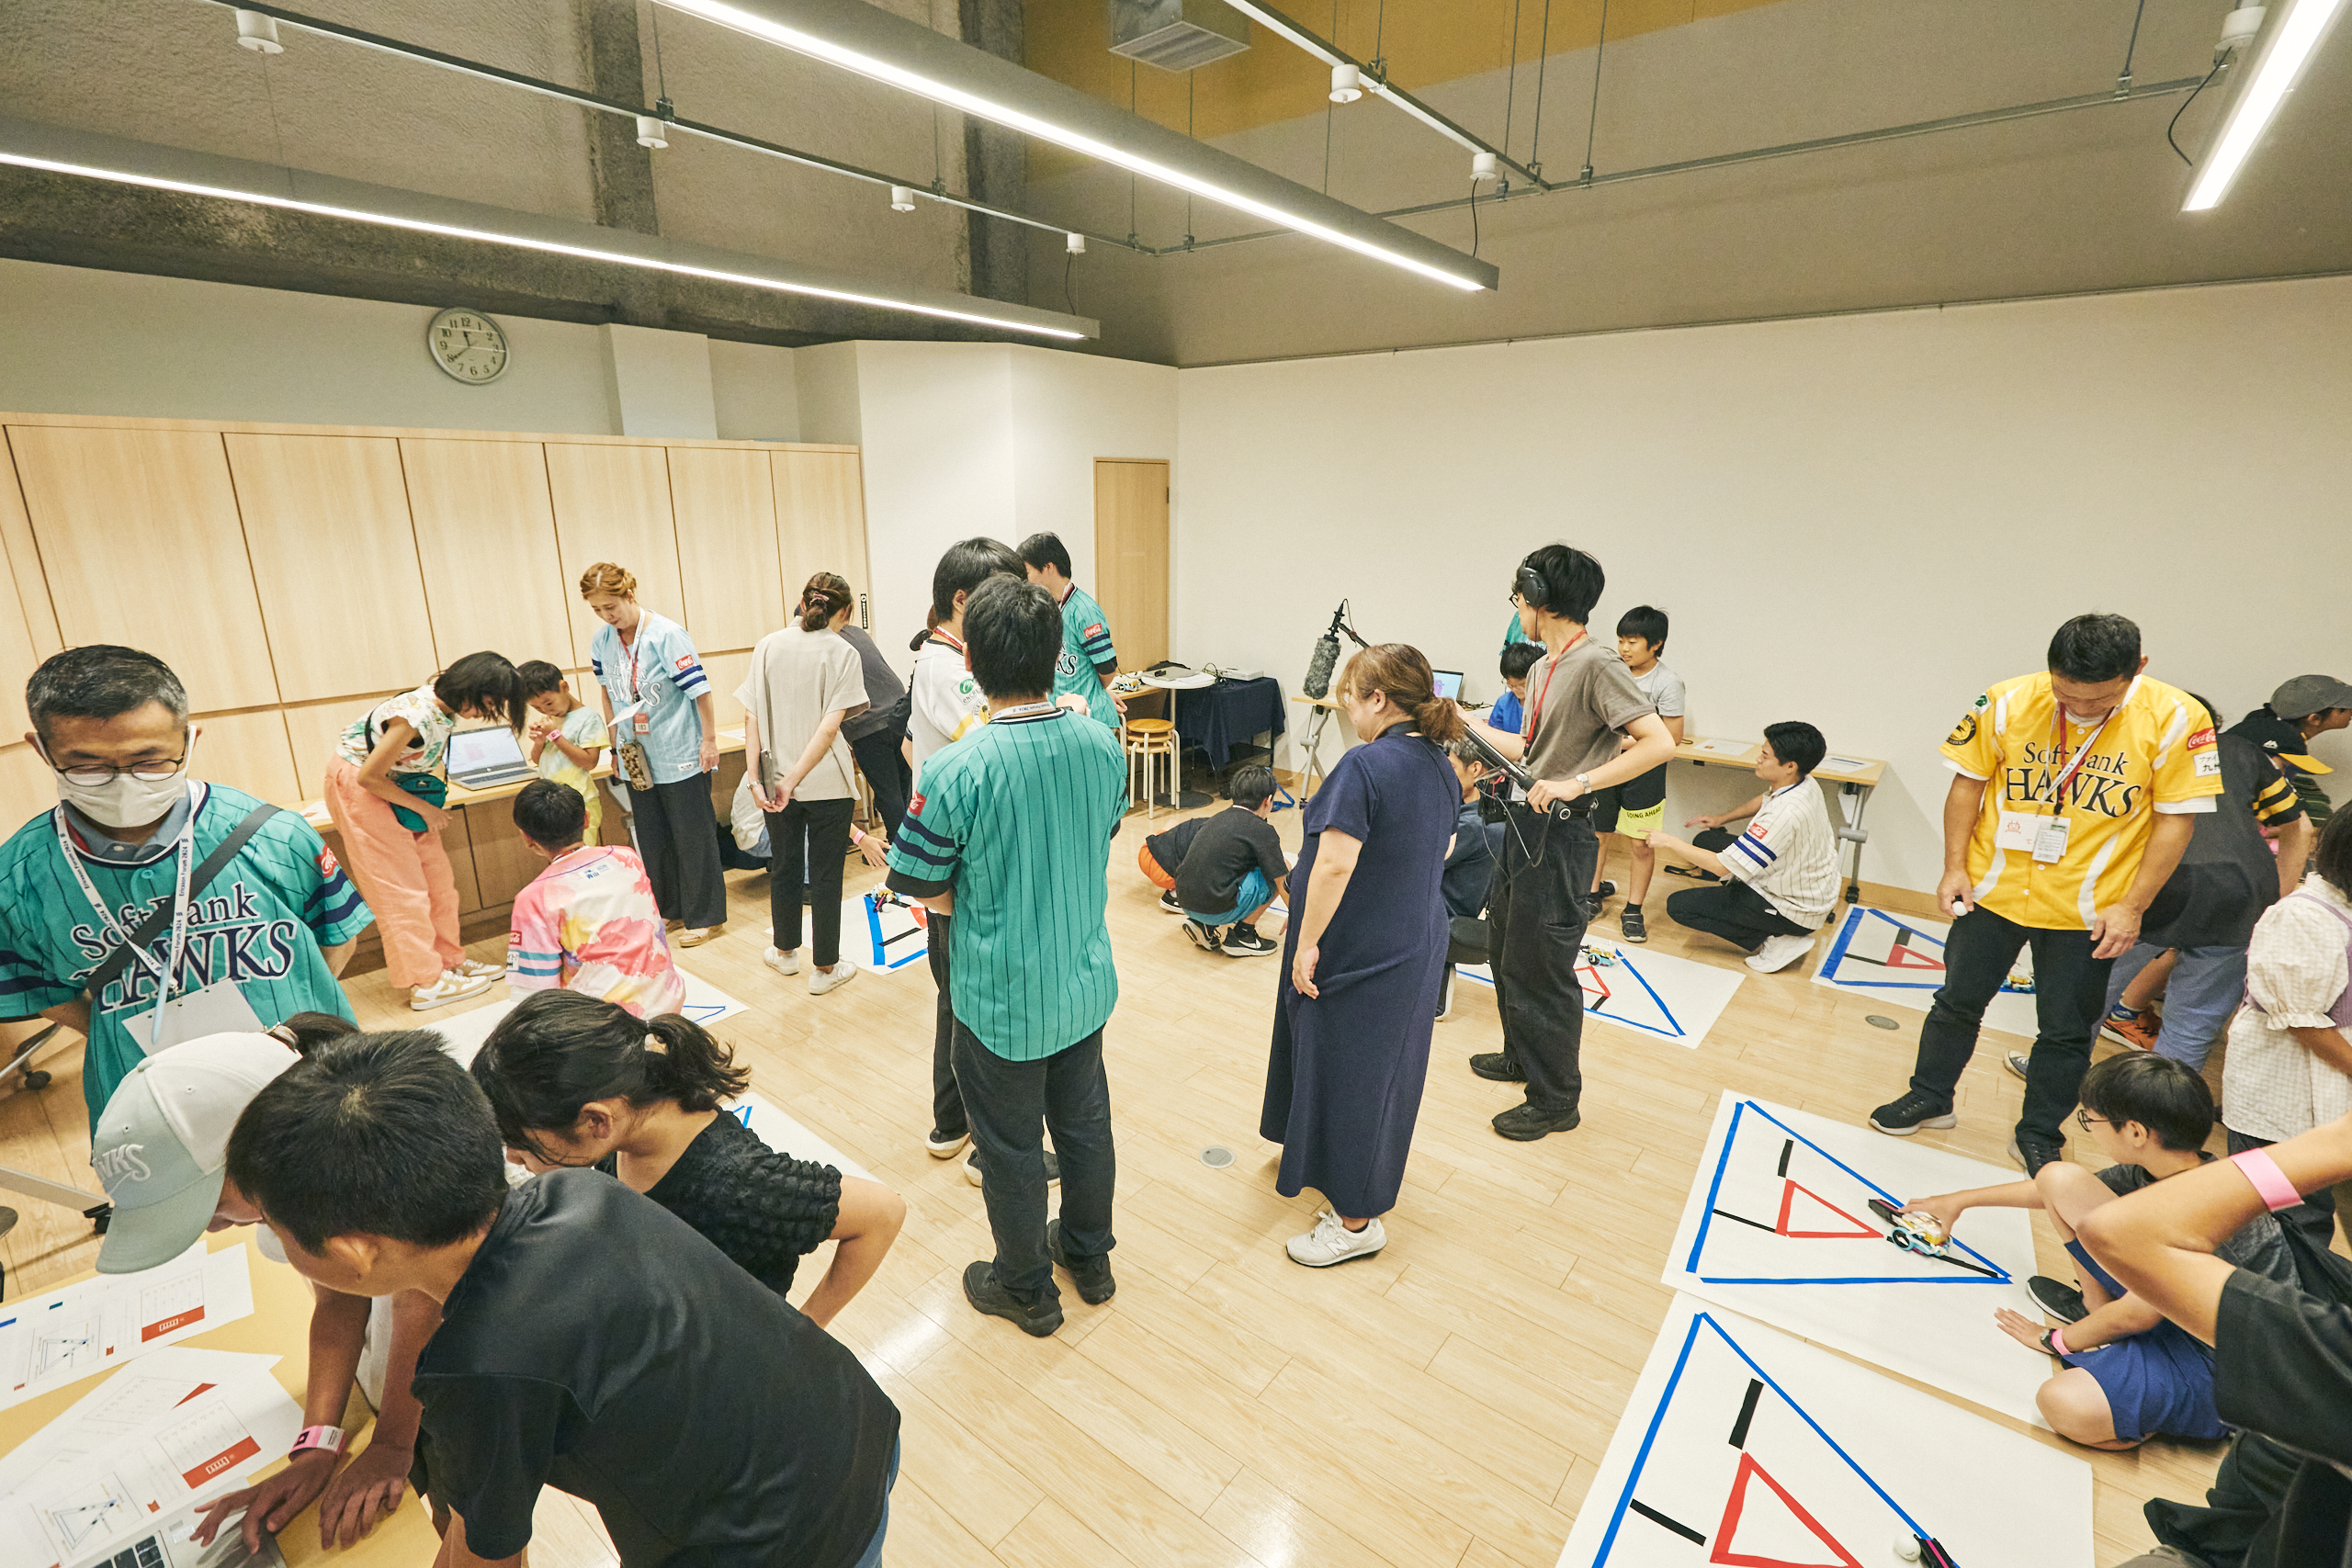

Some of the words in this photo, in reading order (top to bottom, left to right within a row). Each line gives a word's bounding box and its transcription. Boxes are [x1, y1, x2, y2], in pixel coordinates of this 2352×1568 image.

[449, 319, 458, 328] 11
[461, 317, 470, 327] 12
[477, 321, 482, 331] 1
[441, 328, 452, 338] 10
[486, 332, 493, 341] 2
[439, 341, 447, 350] 9
[447, 353, 455, 363] 8
[458, 363, 464, 372] 7
[469, 366, 478, 376] 6
[483, 365, 490, 374] 5
